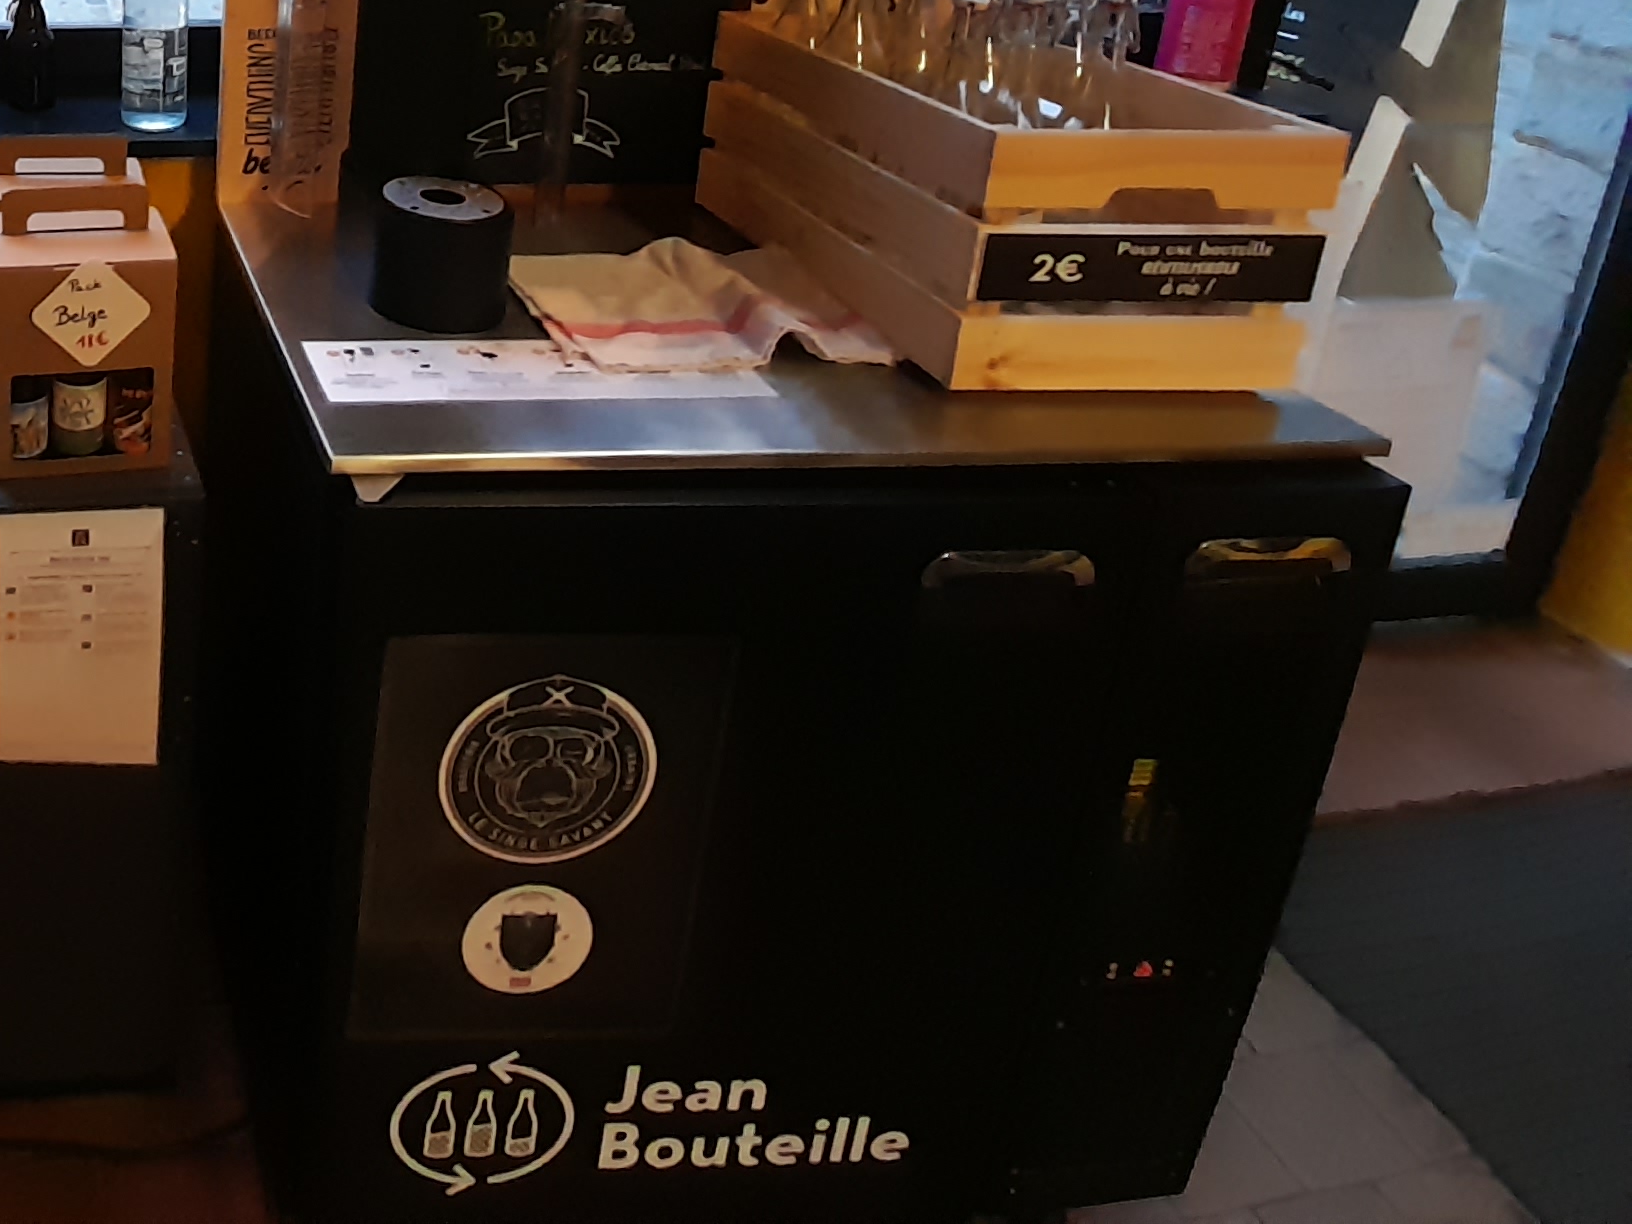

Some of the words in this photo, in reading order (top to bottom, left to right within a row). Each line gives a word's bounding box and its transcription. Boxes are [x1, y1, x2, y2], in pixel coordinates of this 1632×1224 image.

[1028, 253, 1086, 283] 2€
[52, 304, 108, 328] Belge
[604, 1065, 768, 1114] Jean
[598, 1116, 910, 1170] Bouteille
